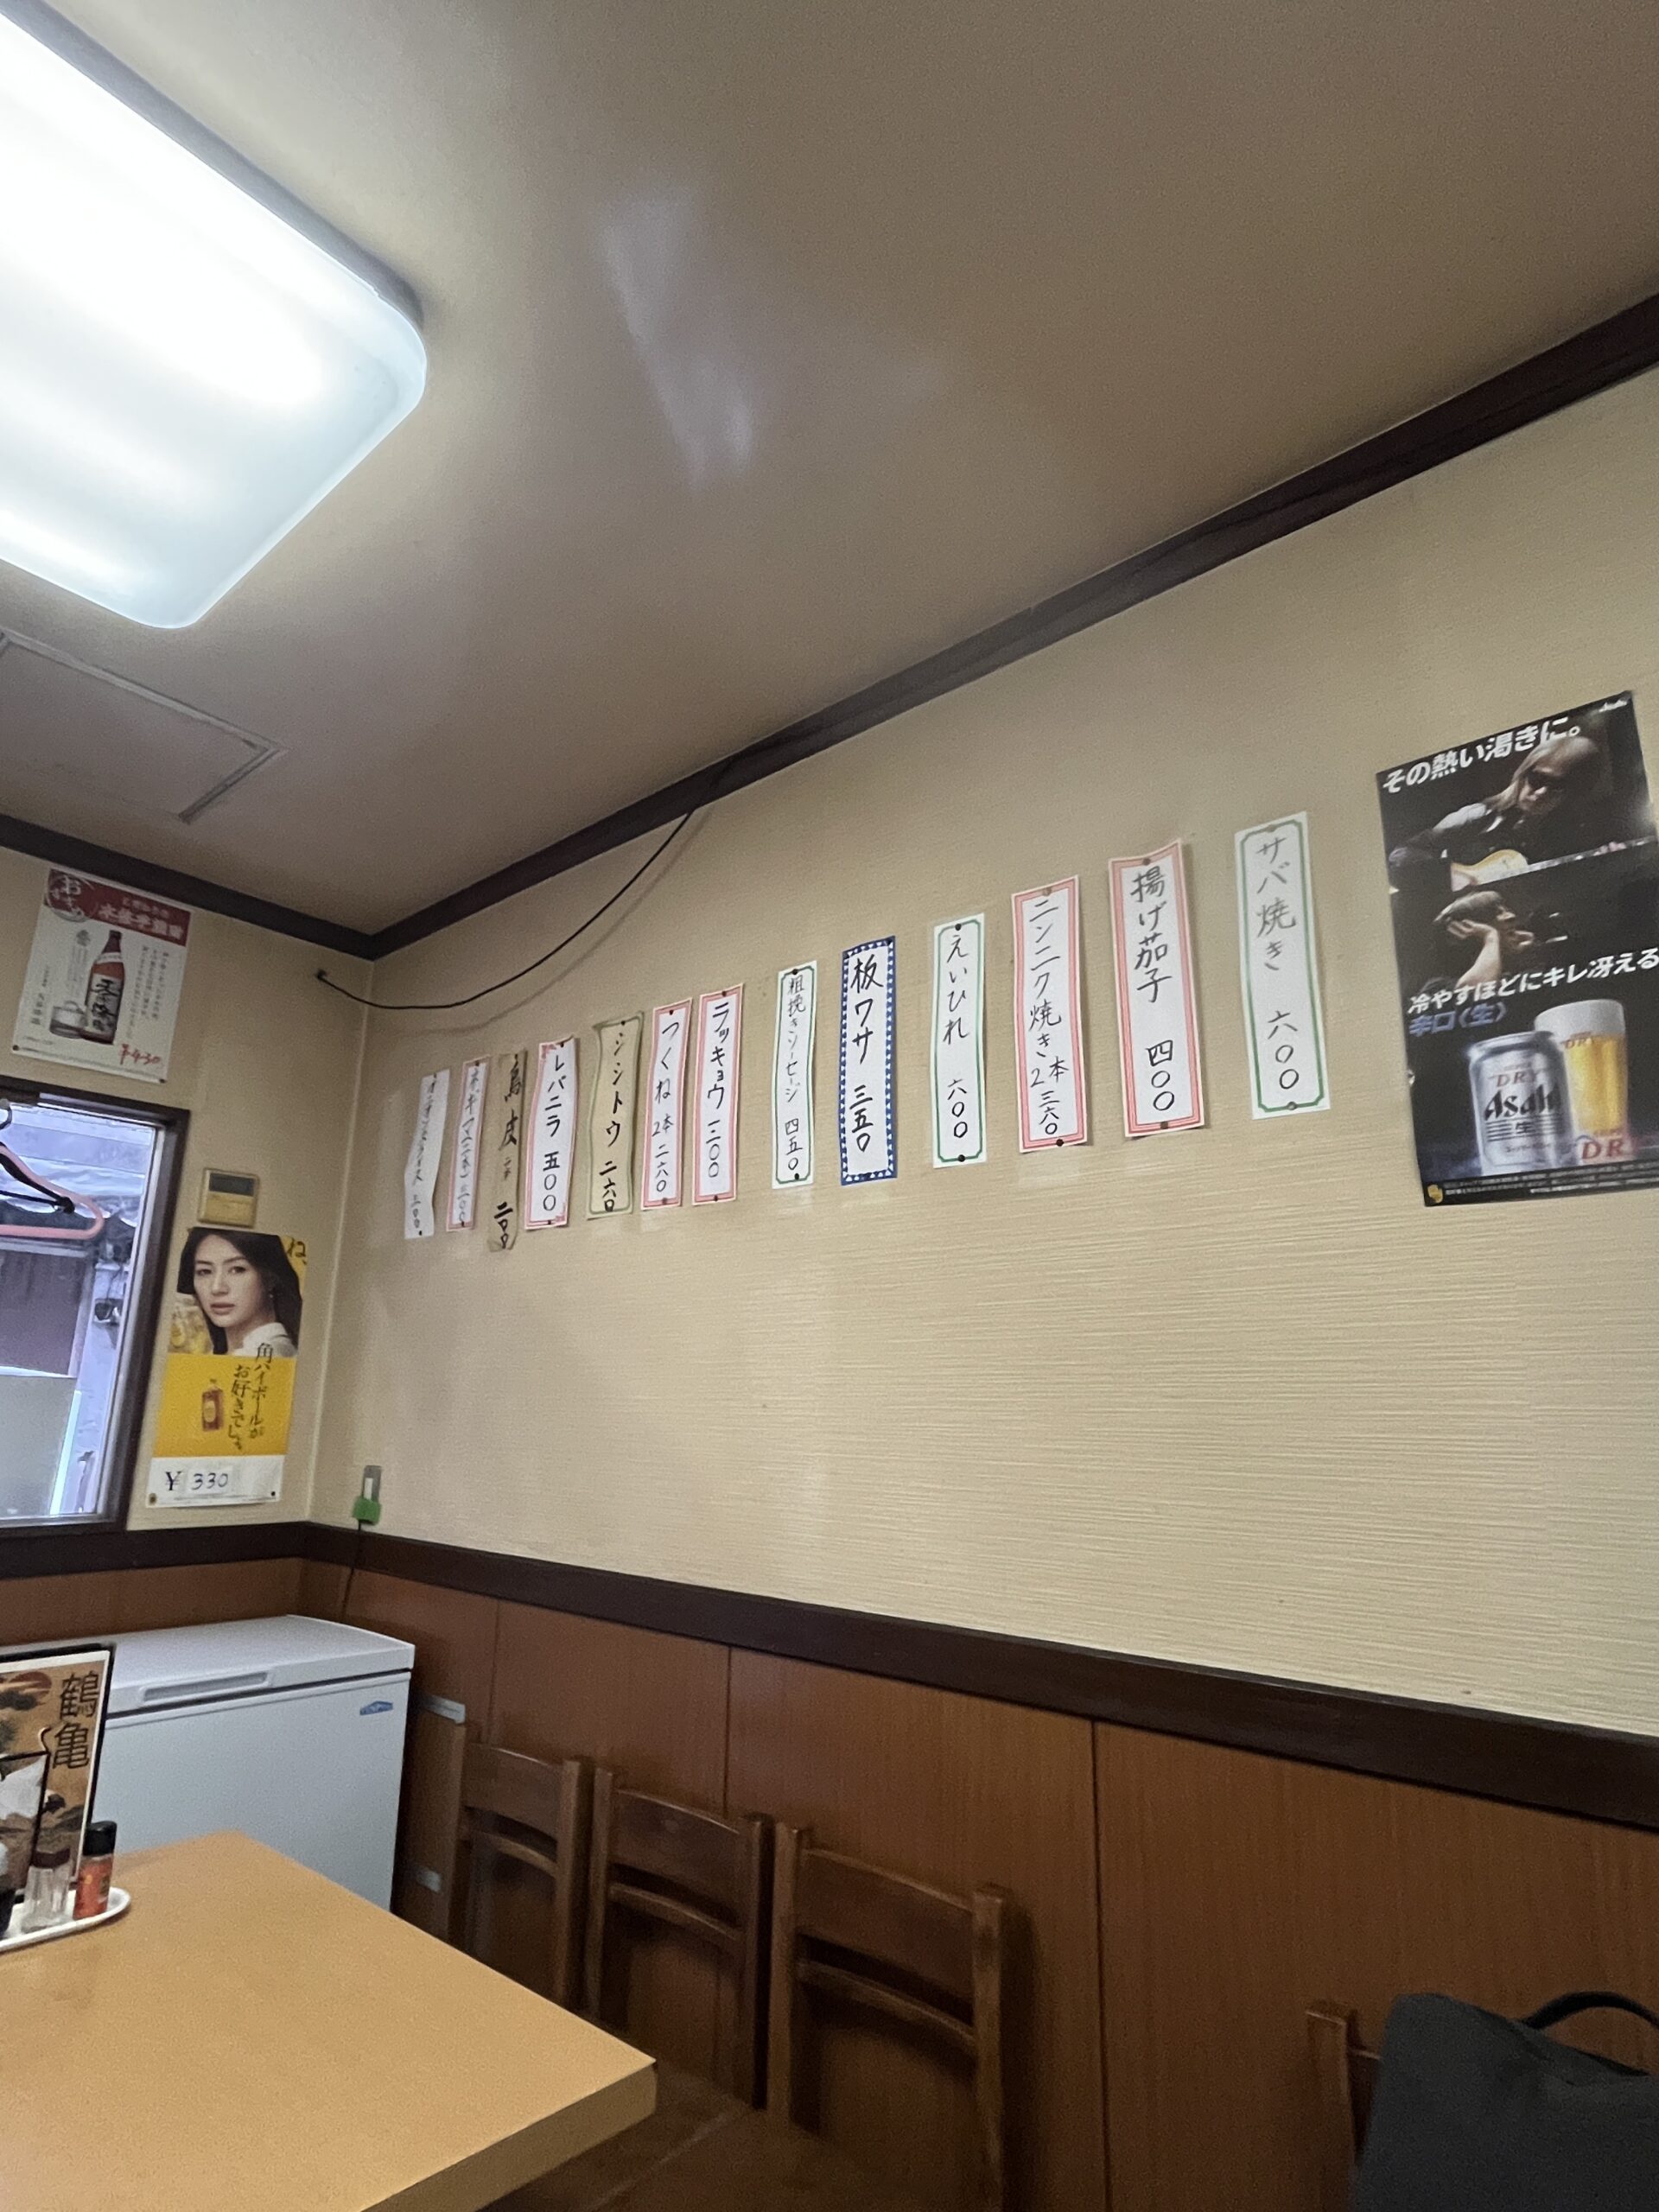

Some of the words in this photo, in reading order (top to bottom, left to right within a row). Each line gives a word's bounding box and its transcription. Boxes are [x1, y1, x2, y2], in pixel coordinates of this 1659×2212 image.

[1383, 716, 1581, 793] その熱い渇きに。
[1130, 866, 1173, 1003] 揚げ茄子
[1256, 836, 1297, 970] サバ焼き
[849, 953, 884, 1065] 板ワサ
[943, 935, 969, 1045] えいひれ
[1028, 899, 1062, 1058] ニンニク焼き
[1408, 947, 1659, 1014] 冷やすほどにキレ冴える
[606, 1032, 624, 1148] シシトウ
[655, 1022, 680, 1104] つくね
[707, 1001, 729, 1110] ラッキョウ
[785, 974, 806, 1103] 粗挽きソーセージ
[544, 1055, 567, 1138] レバニラ
[191, 1472, 229, 1491] 330
[53, 1669, 99, 1769] 鶴亀
